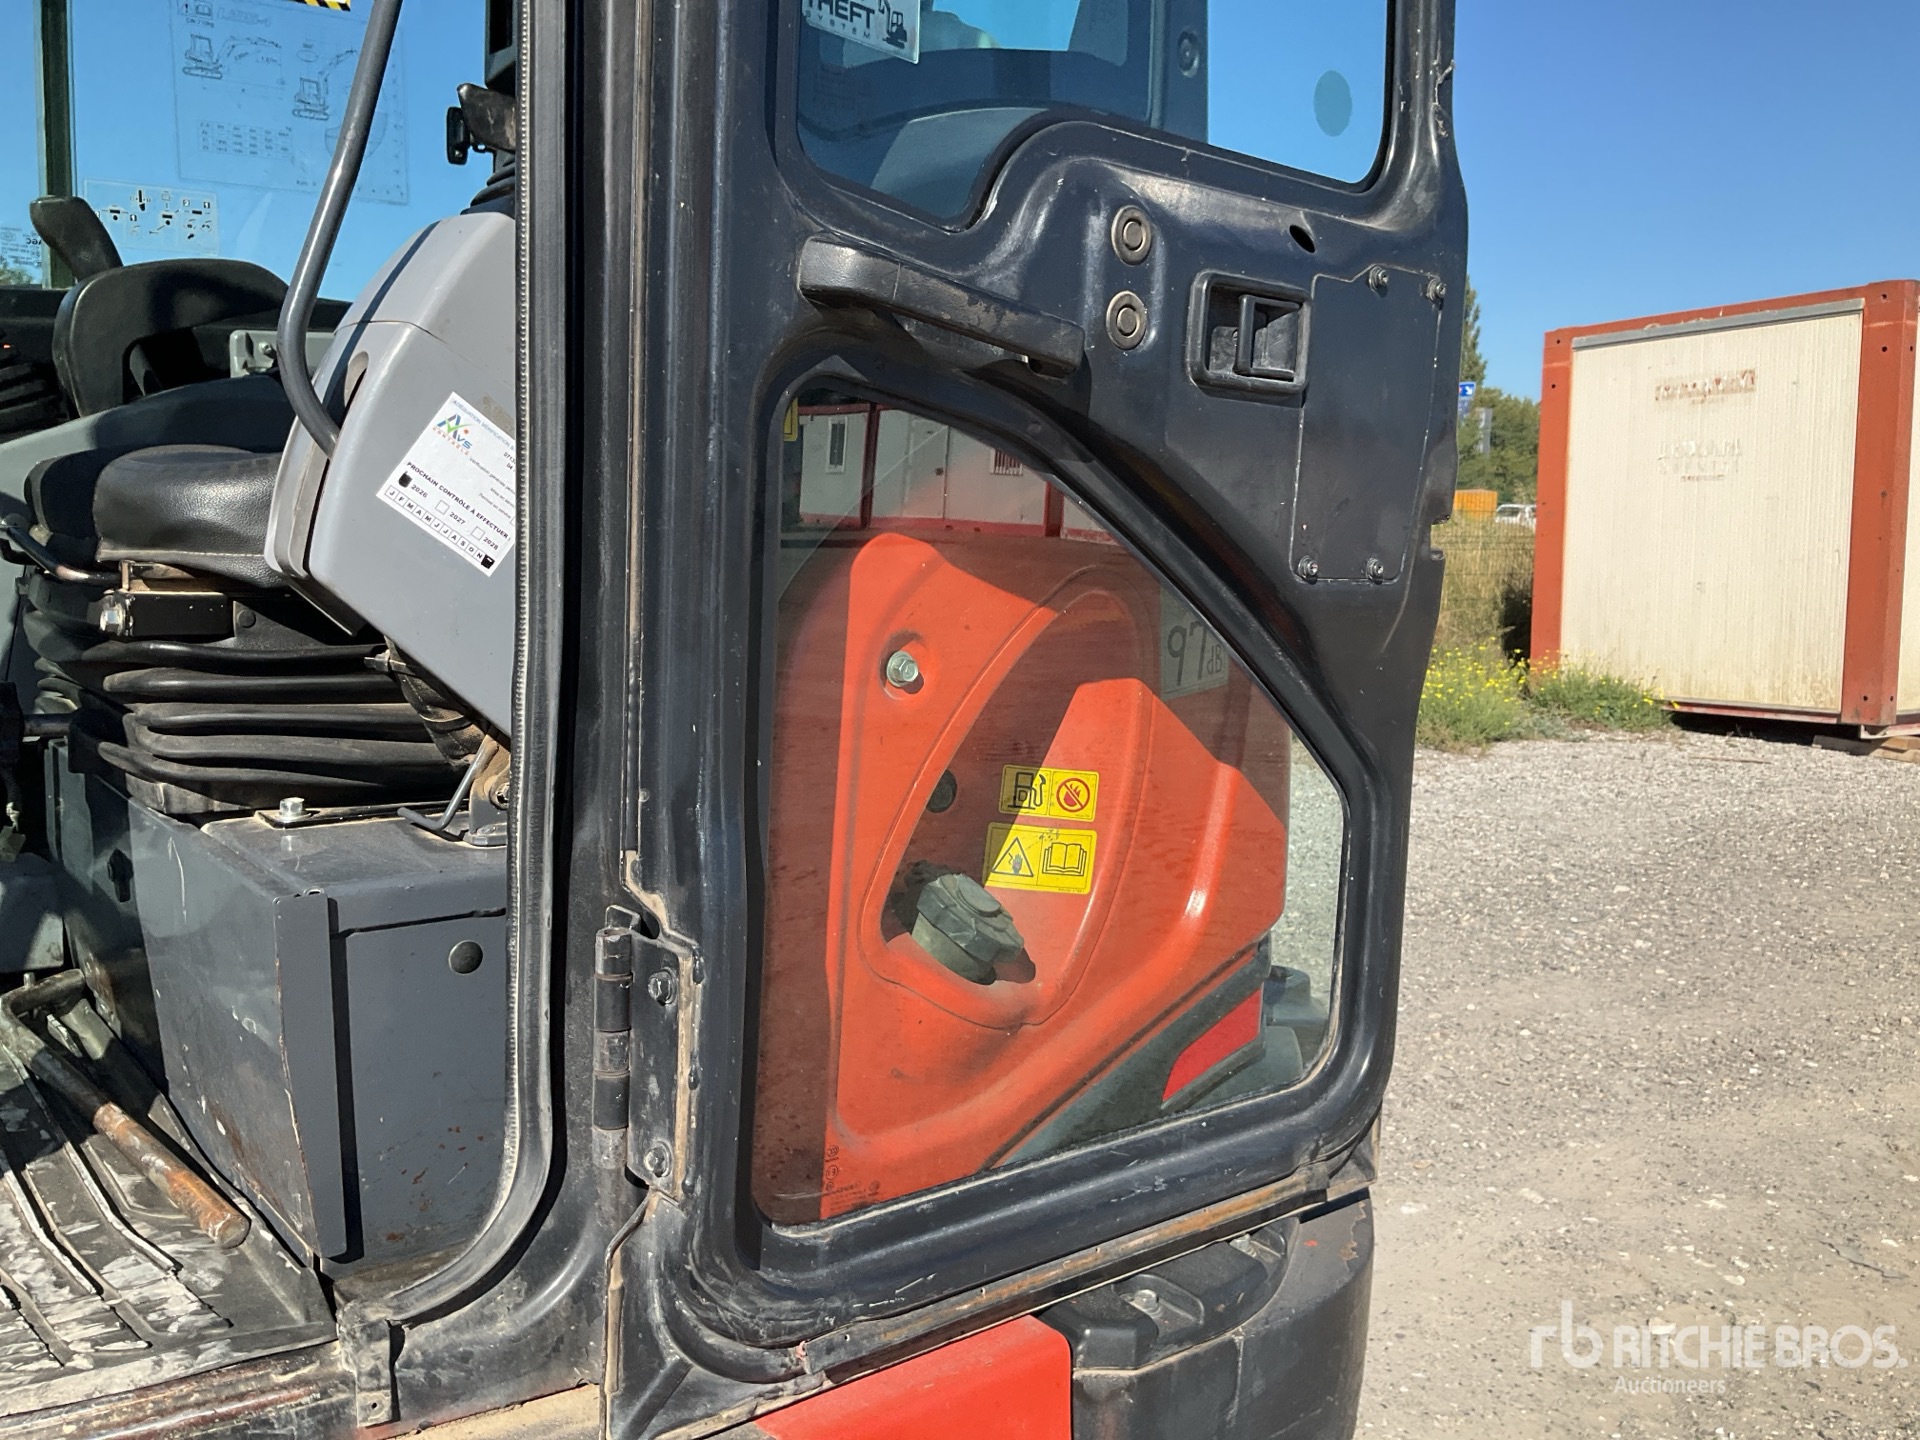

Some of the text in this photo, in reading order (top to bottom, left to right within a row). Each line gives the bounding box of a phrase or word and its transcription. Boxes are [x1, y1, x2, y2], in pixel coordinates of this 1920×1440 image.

[406, 461, 439, 487] PROCHAIN
[438, 484, 471, 510] CONTRÔLE
[476, 512, 509, 539] EFFECTUER
[411, 484, 500, 551] 2026 2027 2028
[1167, 620, 1222, 686] 97 dB
